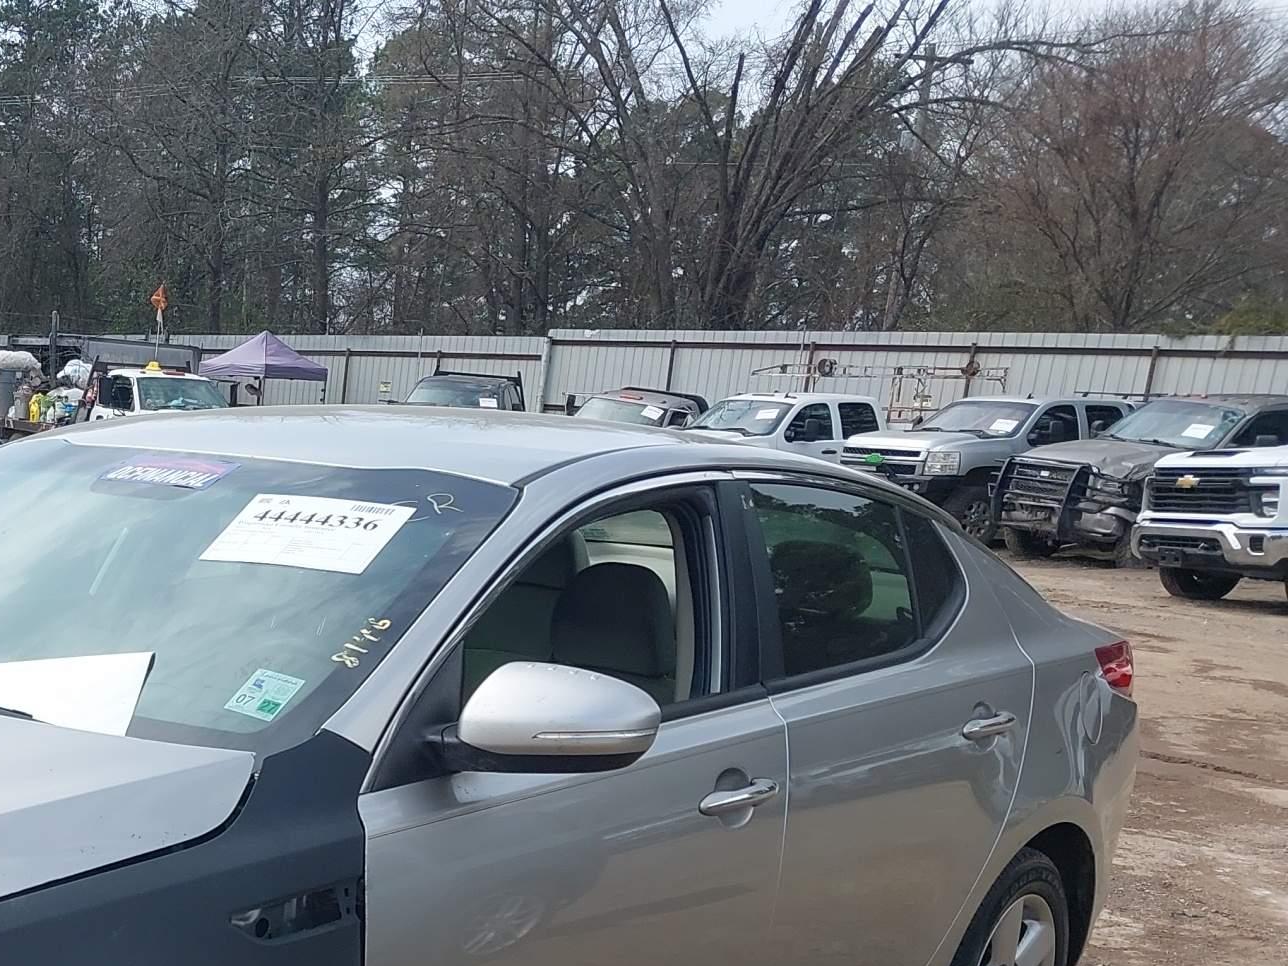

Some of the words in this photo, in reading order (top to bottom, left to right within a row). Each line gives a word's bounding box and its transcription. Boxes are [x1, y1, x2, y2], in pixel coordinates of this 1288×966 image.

[427, 493, 464, 514] R
[253, 509, 383, 531] 44444336
[236, 693, 255, 706] 07
[257, 699, 281, 713] 27
